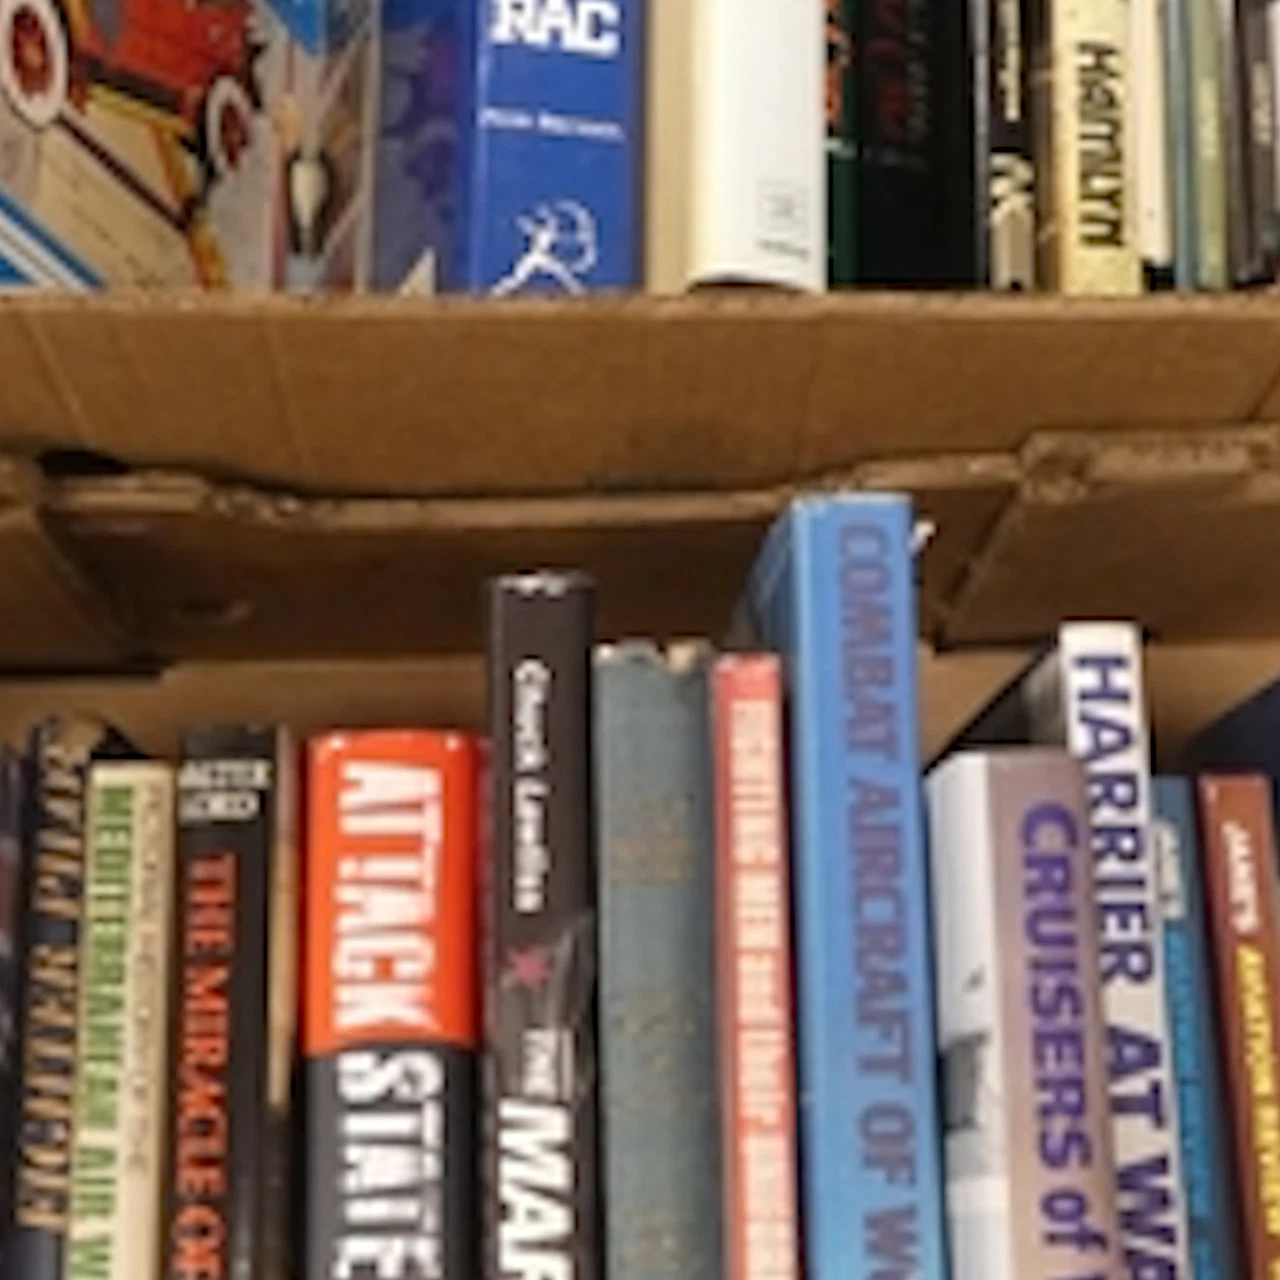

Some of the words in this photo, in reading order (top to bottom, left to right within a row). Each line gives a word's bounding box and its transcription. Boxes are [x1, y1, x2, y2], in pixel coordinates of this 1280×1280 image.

[1074, 39, 1126, 254] HAMLYN
[836, 520, 895, 757] COMBAT
[512, 661, 547, 767] Chuck
[1072, 649, 1156, 986] HARRIER
[1221, 820, 1261, 933] JANE'S
[77, 783, 137, 1134] MEDITERRANEAN
[182, 850, 237, 954] THE
[330, 758, 446, 1036] ATTACK
[846, 776, 911, 1091] AIRCRAFT
[1015, 801, 1101, 1170] CRUISERS
[1235, 945, 1279, 1098] AVIATION
[172, 962, 233, 1196] MIRACLE
[517, 1027, 558, 1098] THE
[1101, 1019, 1168, 1143] AT
[70, 1142, 121, 1224] AIR
[858, 1103, 915, 1189] OF
[171, 1204, 224, 1280] OF
[1037, 1186, 1105, 1258] of
